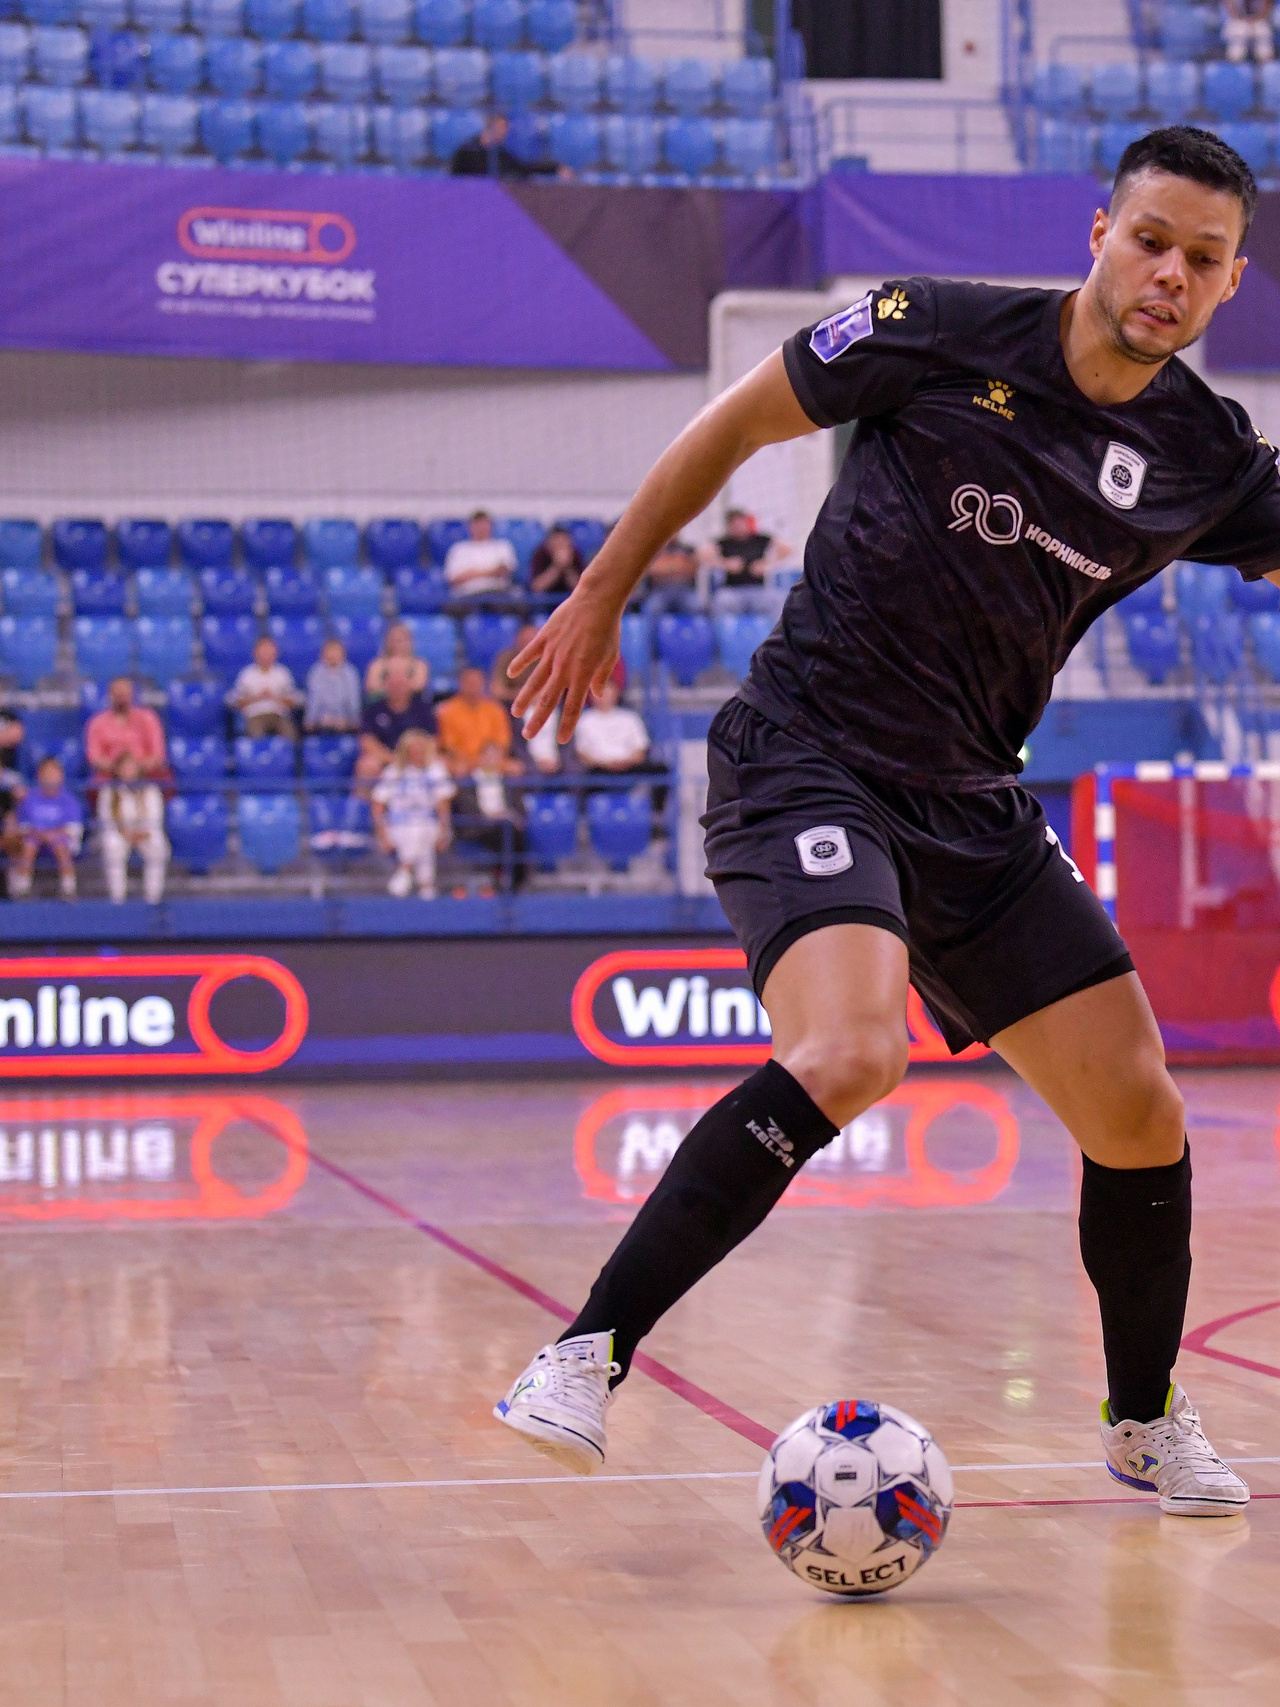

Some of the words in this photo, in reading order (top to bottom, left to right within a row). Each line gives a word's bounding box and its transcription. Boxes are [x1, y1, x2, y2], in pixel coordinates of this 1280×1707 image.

[191, 217, 307, 251] Winline
[156, 261, 376, 302] СУПЕРКУБОК
[972, 395, 1016, 421] KELME
[1024, 523, 1113, 581] НОРНИКЕЛЬ
[612, 975, 773, 1038] Win
[806, 1555, 907, 1587] SELECT
